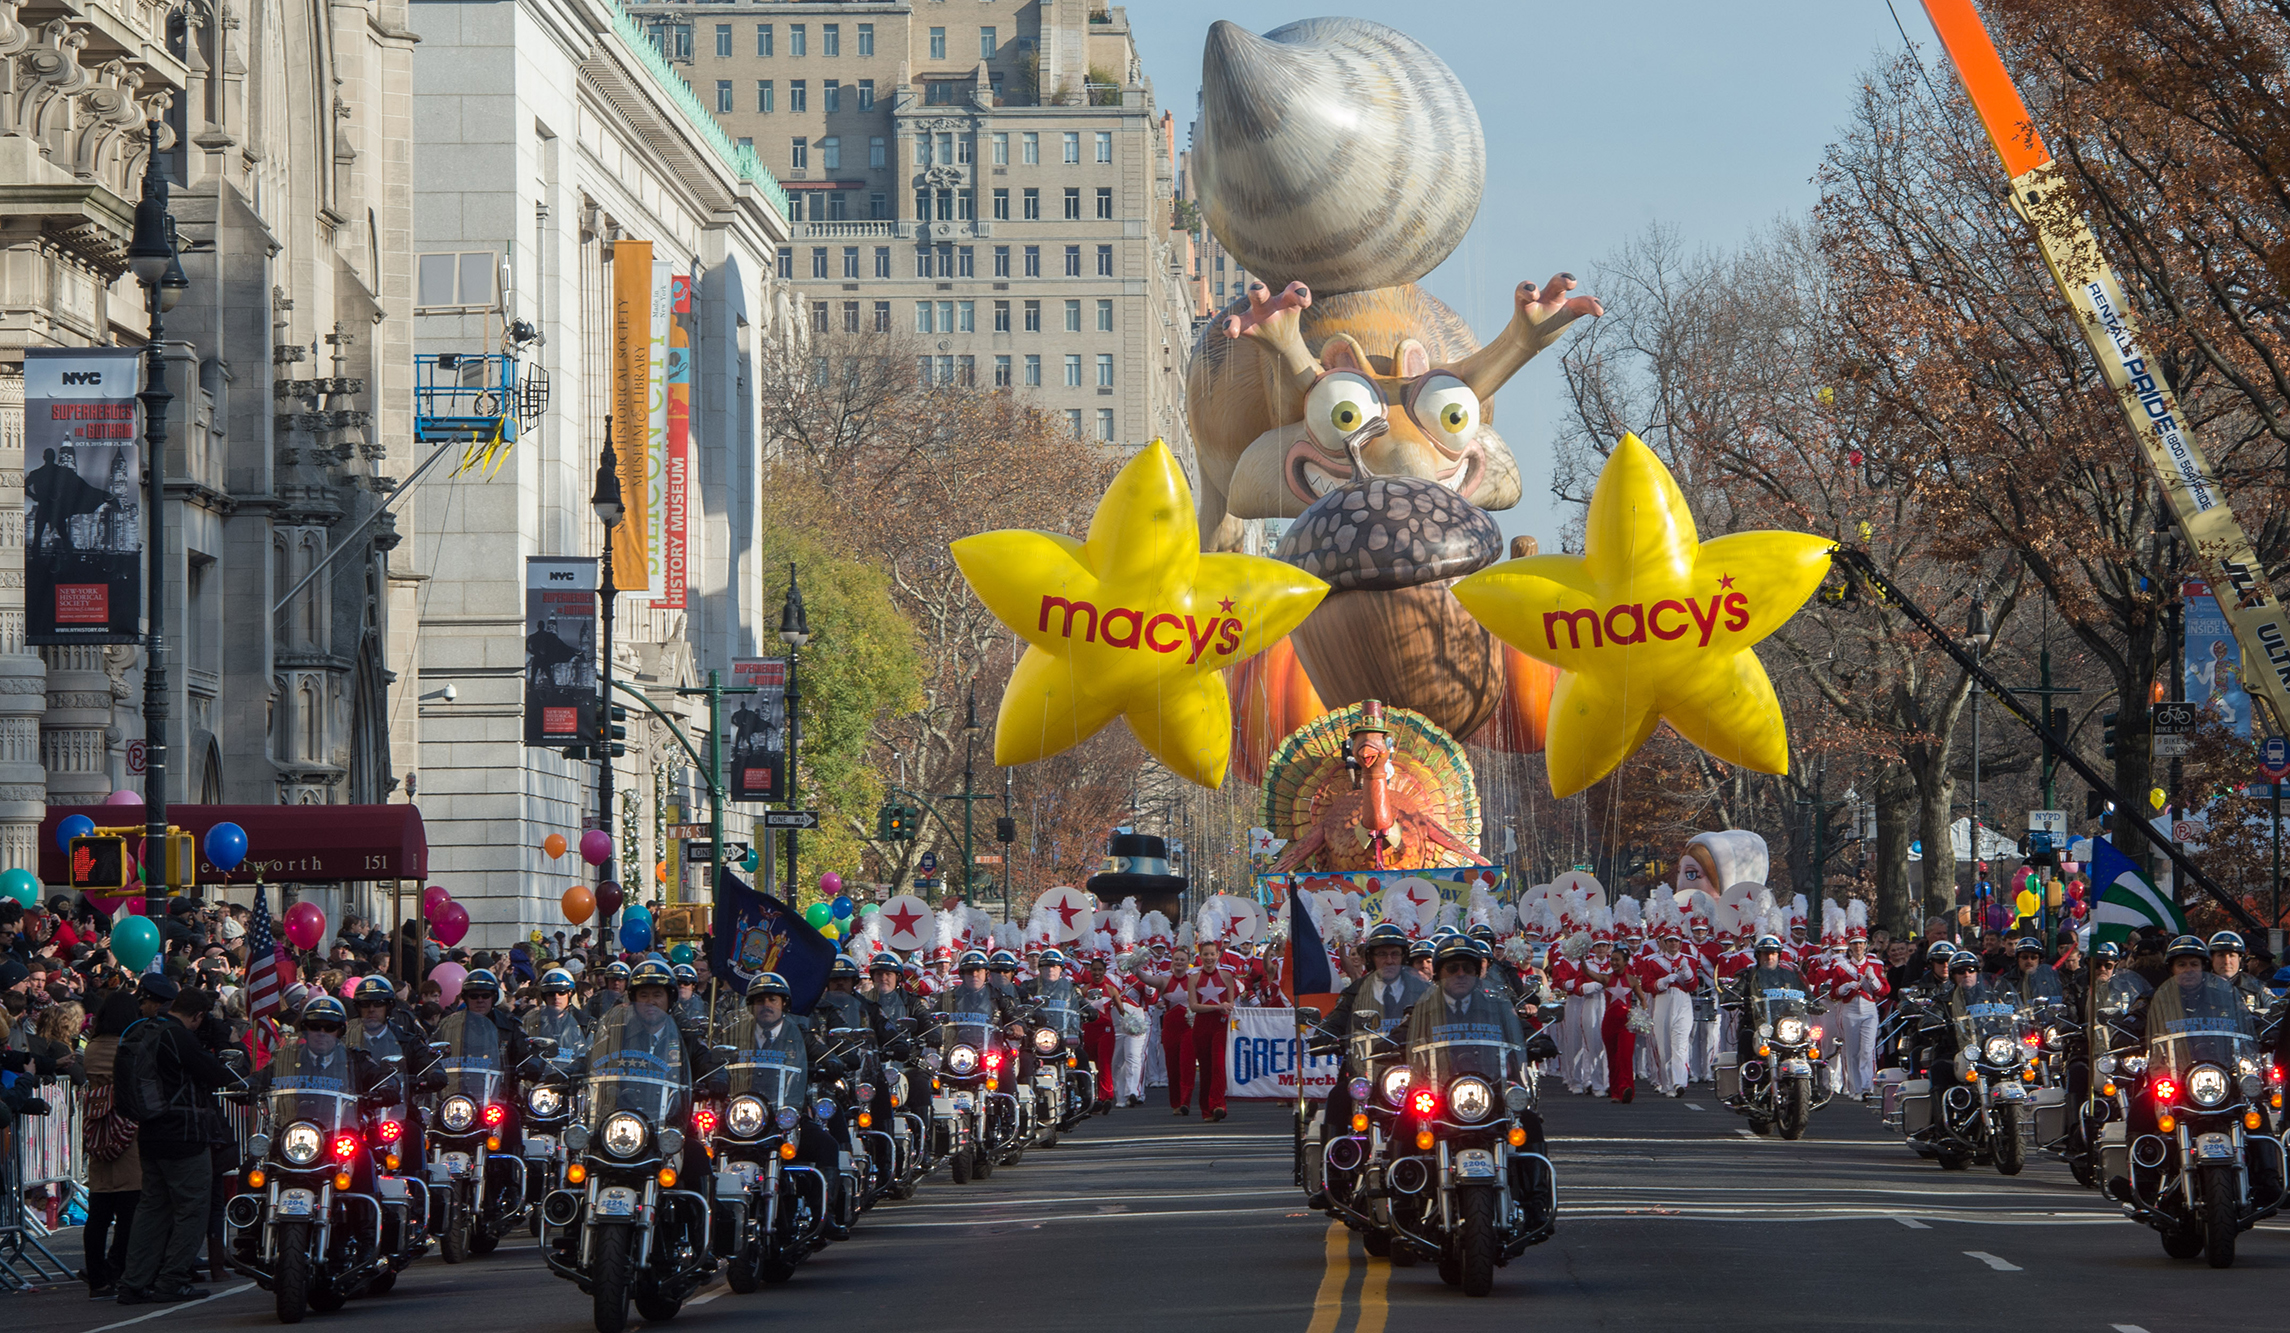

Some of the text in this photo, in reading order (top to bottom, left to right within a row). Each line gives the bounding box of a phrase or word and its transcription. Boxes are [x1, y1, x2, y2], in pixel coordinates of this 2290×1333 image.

[617, 298, 629, 359] SOCIETY
[2089, 283, 2133, 358] RENTALS
[2123, 358, 2178, 435] PRIDE
[2167, 433, 2186, 459] (800)
[62, 372, 101, 385] NYC
[51, 404, 133, 420] SUPERHEROES
[616, 366, 628, 451] HISTORICAL
[631, 345, 647, 487] MUSEUM & LIBRARY
[87, 423, 133, 439] GOTHAM
[670, 457, 684, 605] HISTORY MUSEUM
[549, 572, 575, 580] NYC
[542, 592, 594, 603] SUPERHEROES
[2188, 626, 2220, 634] INSIDE
[771, 816, 787, 824] ONE
[668, 827, 677, 838] W
[680, 827, 692, 838] 76
[696, 848, 712, 856] ONE
[364, 855, 388, 870] 151
[1432, 1023, 1502, 1034] HIGHWAY PATROL
[1432, 1032, 1503, 1041] NYPD POLICE
[756, 1050, 787, 1058] PATROL
[1234, 1036, 1318, 1085] GREA
[628, 1068, 666, 1079] POLICE
[305, 1081, 341, 1091] POLICE
